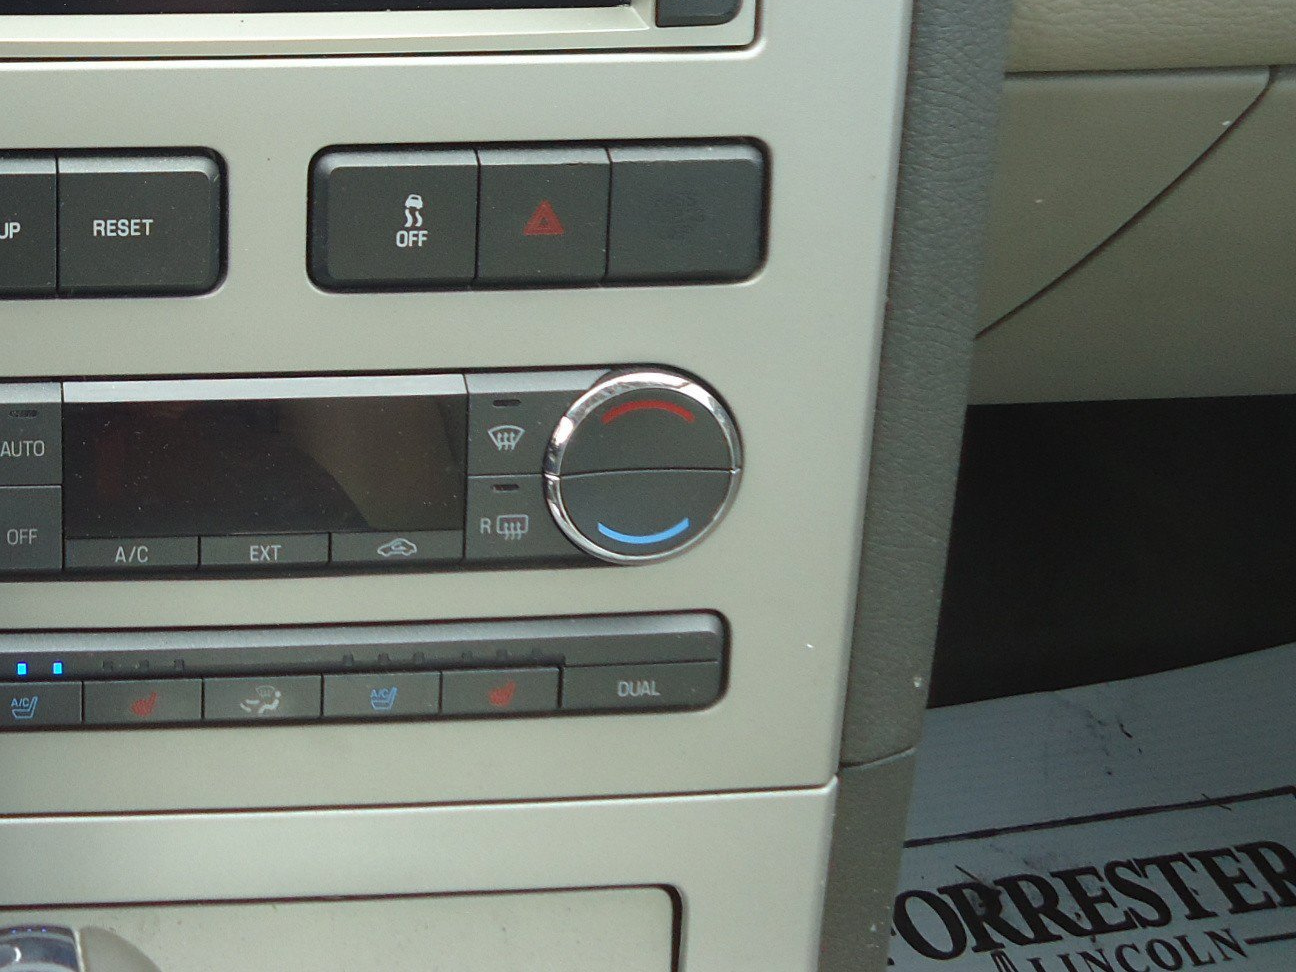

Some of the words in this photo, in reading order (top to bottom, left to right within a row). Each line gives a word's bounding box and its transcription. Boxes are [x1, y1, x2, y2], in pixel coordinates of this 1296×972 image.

[93, 218, 154, 237] RESET
[395, 230, 429, 248] OFF
[0, 440, 45, 458] AUTO
[480, 517, 492, 534] R
[6, 528, 38, 546] OFF
[114, 545, 149, 563] A/C
[249, 544, 282, 562] EXT
[617, 680, 661, 697] DUAL
[10, 697, 32, 708] A/C
[887, 840, 1296, 961] ORRESTER
